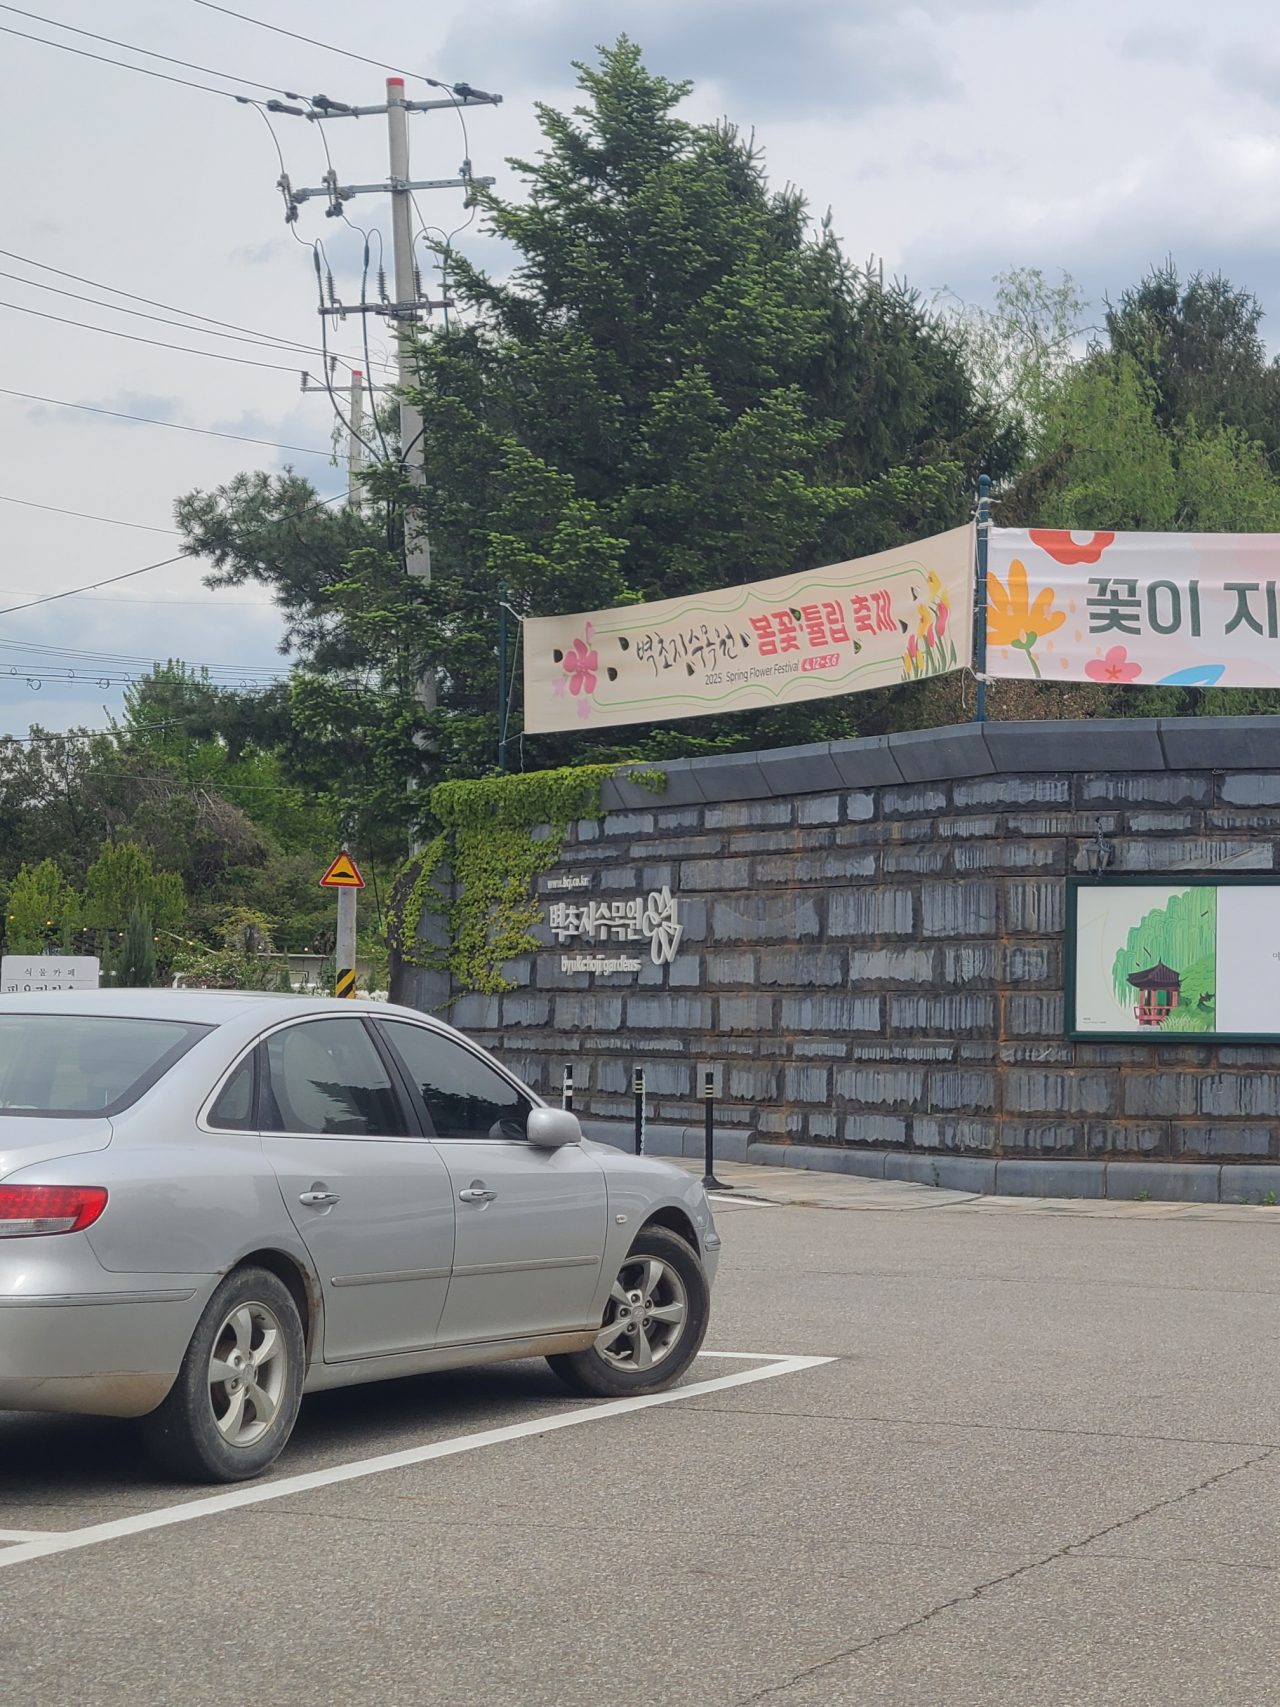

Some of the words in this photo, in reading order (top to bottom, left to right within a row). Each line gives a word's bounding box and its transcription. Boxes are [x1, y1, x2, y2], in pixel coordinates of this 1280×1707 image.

[850, 589, 897, 635] 축제
[1086, 578, 1201, 637] 꽃이
[705, 673, 722, 685] 2025
[726, 669, 749, 682] Spring
[749, 663, 773, 677] Flower
[773, 659, 800, 674] Festival
[549, 898, 643, 942] 벽초지수목원
